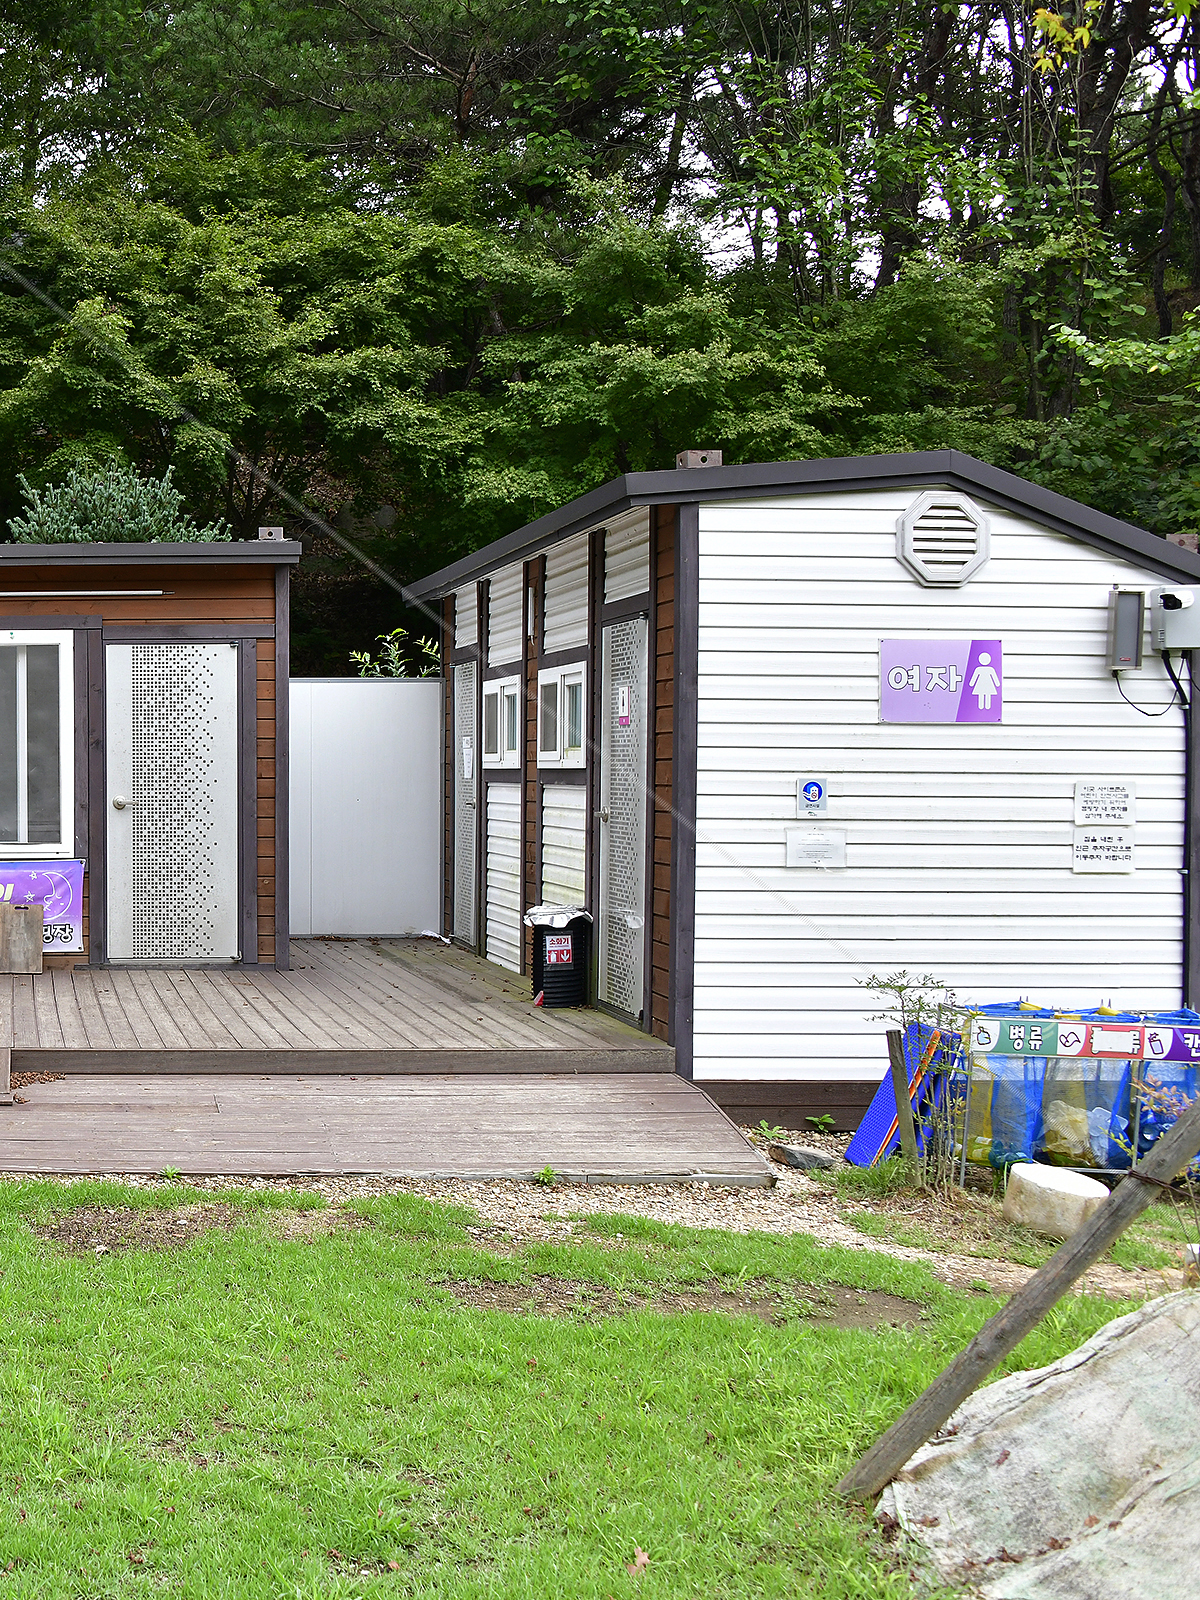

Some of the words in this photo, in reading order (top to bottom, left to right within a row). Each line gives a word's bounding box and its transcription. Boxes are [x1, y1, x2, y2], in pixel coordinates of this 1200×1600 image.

[887, 665, 963, 692] 여자
[549, 937, 569, 945] 소화기
[1009, 1025, 1043, 1051] 병류
